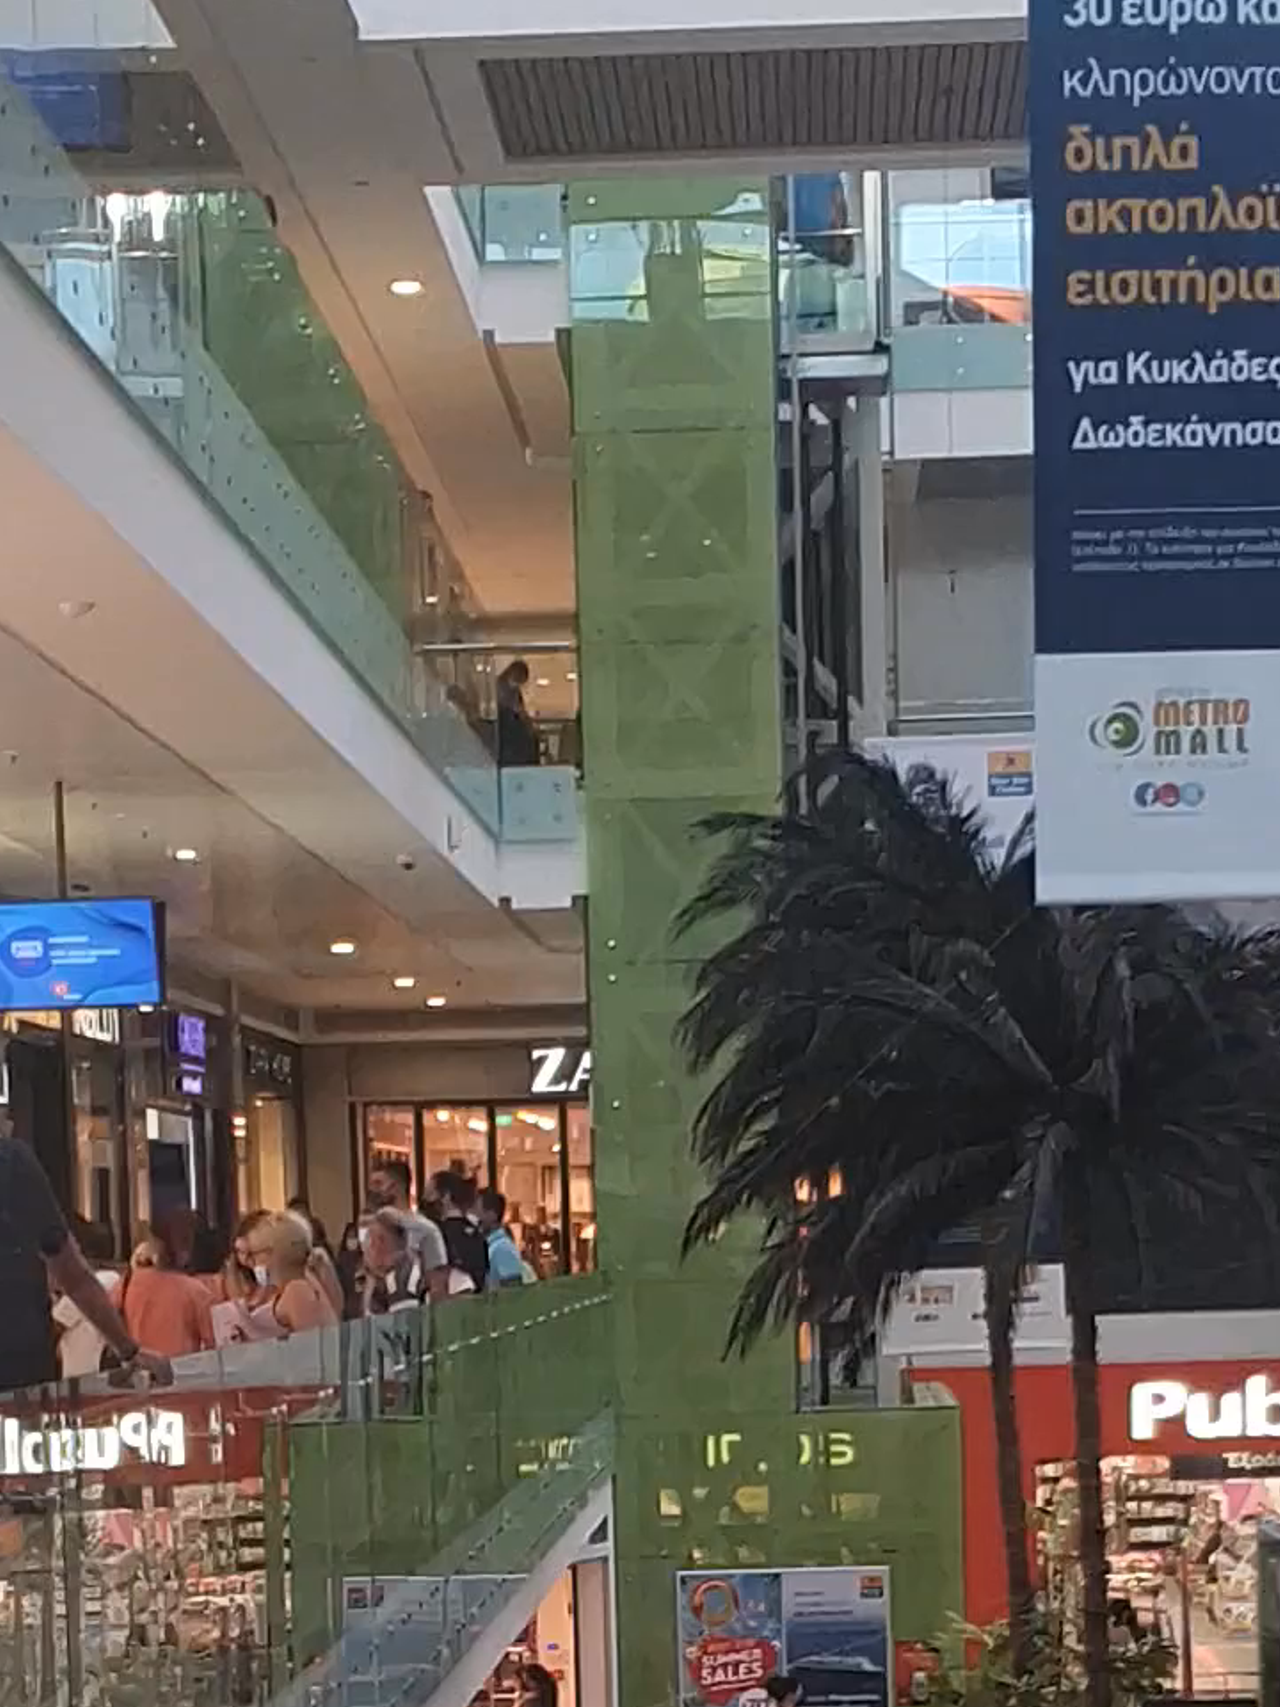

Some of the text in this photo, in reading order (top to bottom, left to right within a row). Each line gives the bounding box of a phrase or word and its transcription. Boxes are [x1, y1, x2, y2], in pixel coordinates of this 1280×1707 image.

[1065, 123, 1199, 174] διπλά
[1068, 354, 1118, 396] για
[701, 1662, 763, 1685] SALES
